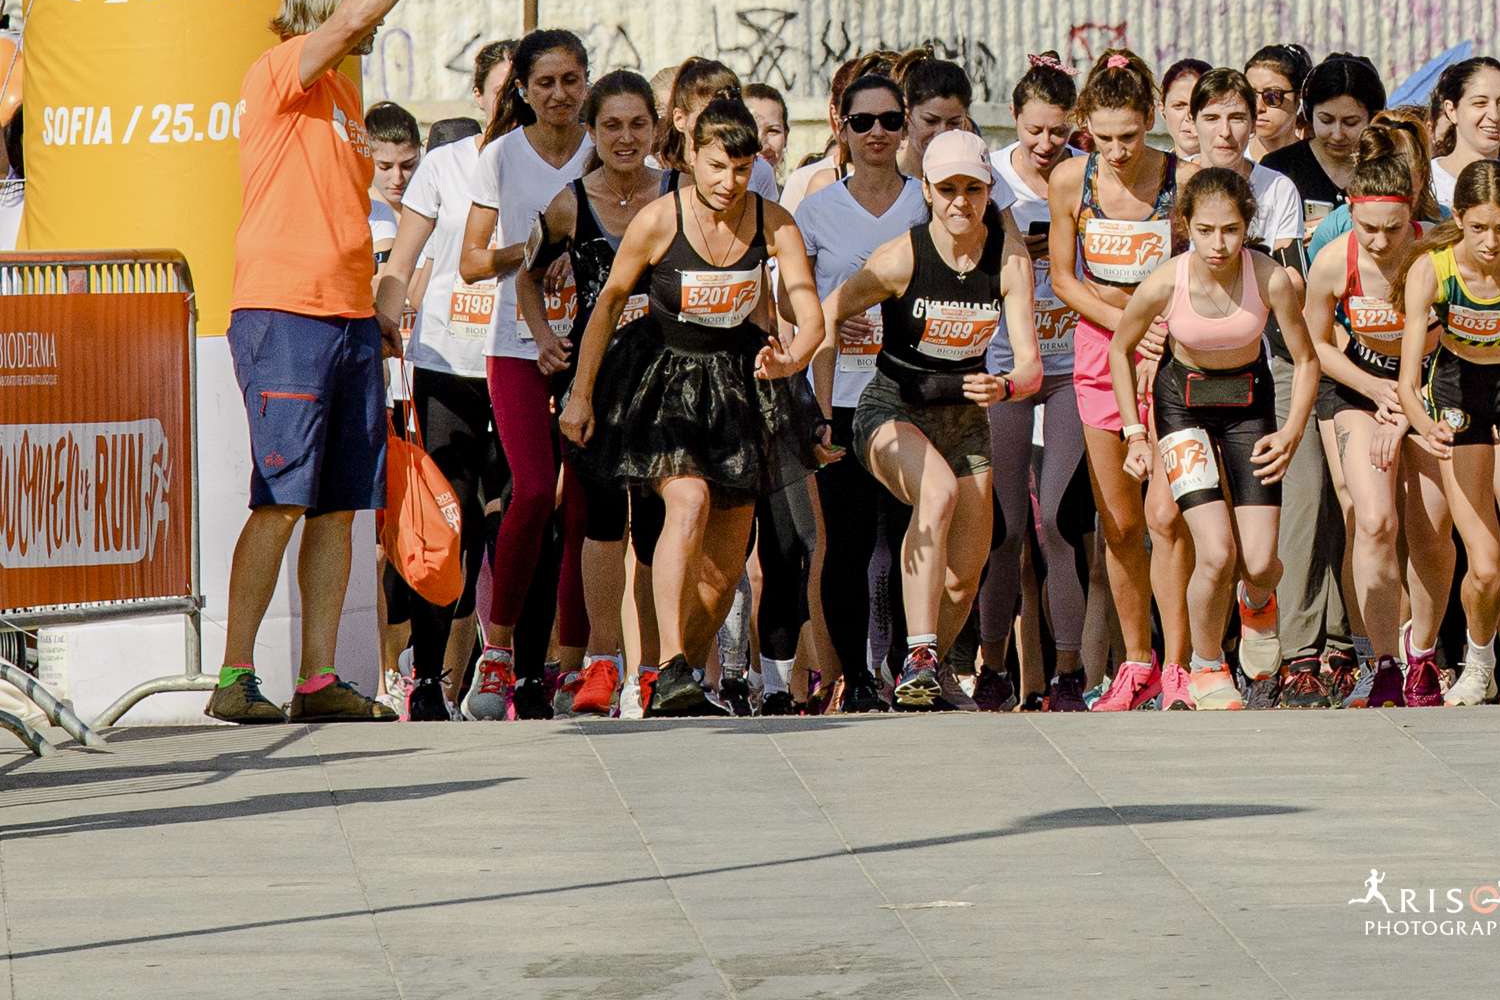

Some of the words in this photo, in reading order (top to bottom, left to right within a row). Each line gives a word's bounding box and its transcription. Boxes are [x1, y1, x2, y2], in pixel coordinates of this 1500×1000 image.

[42, 107, 113, 146] SOFIA
[1089, 235, 1132, 256] 3222
[454, 294, 492, 315] 3198
[688, 286, 730, 306] 5201
[1356, 309, 1398, 328] 3224
[1453, 314, 1498, 330] 8035
[928, 320, 974, 339] 5099
[1353, 342, 1398, 371] NIKE
[95, 433, 144, 553] RUN
